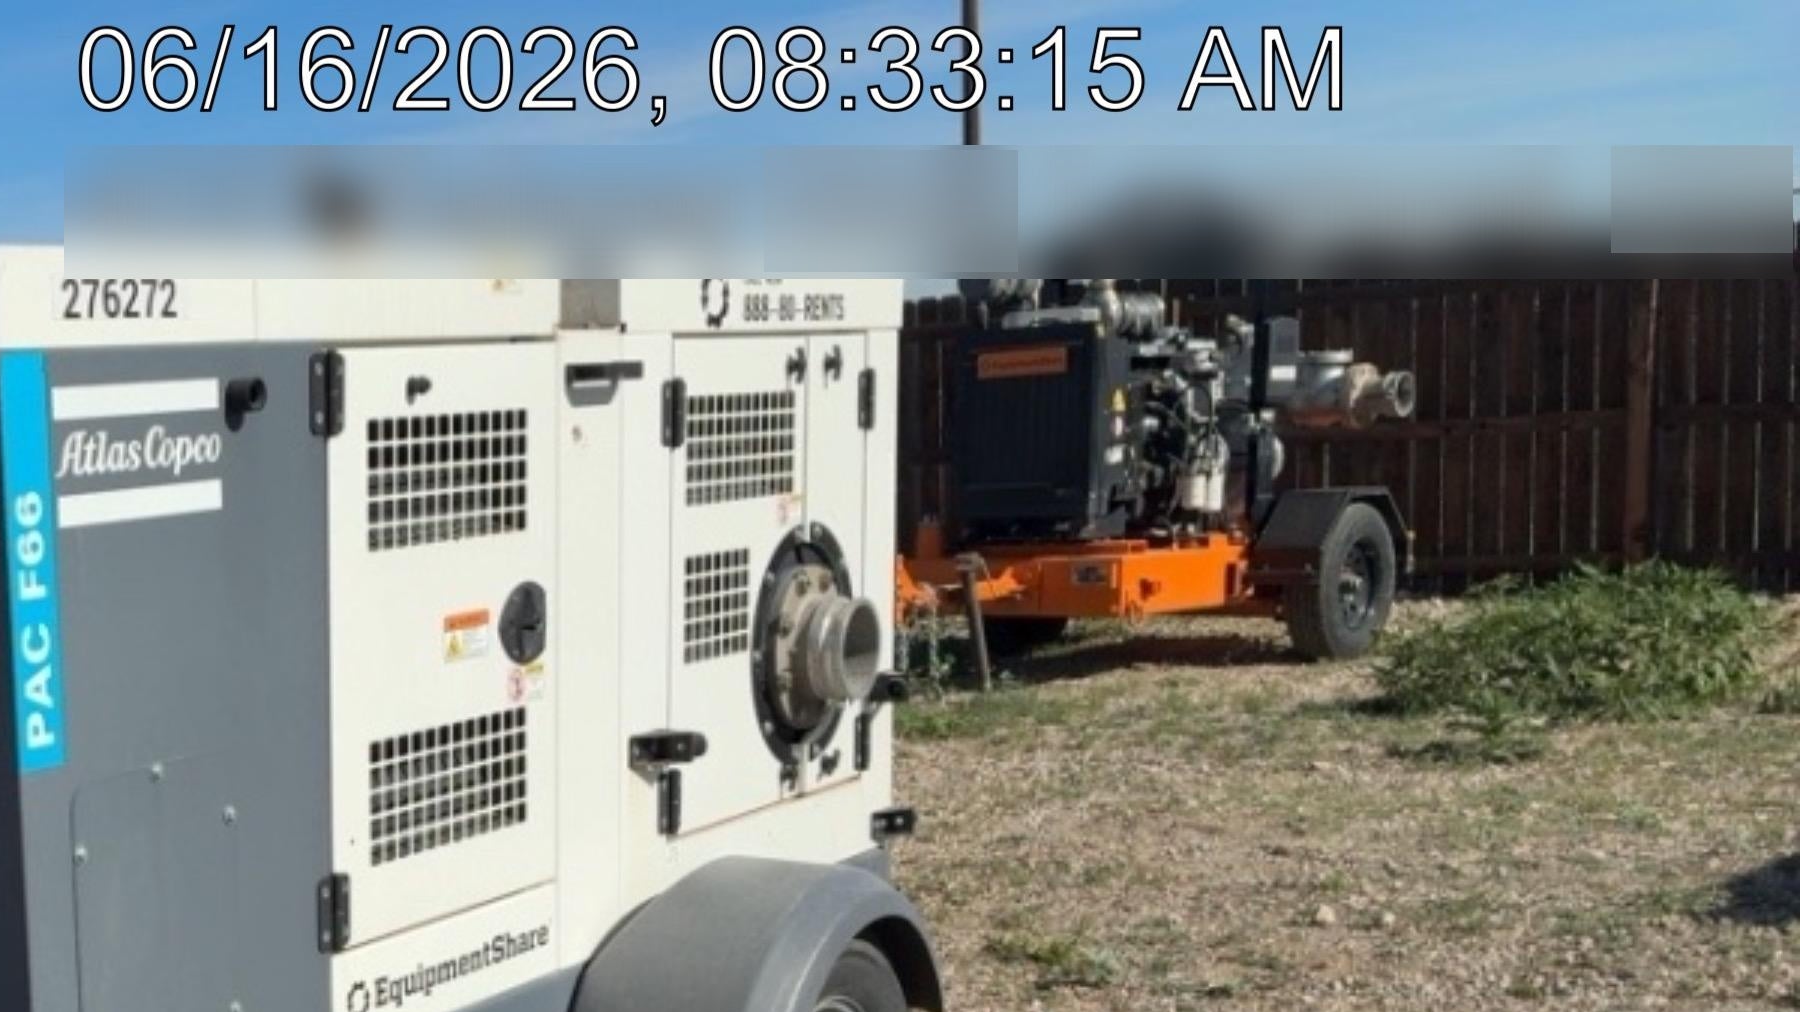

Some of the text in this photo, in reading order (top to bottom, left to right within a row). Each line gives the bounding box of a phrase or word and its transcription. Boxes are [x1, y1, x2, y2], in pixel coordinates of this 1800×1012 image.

[61, 279, 178, 319] 276272
[55, 425, 222, 478] Atlas Copco
[15, 491, 55, 748] PAC F66
[374, 924, 550, 1008] EquipmentShare
